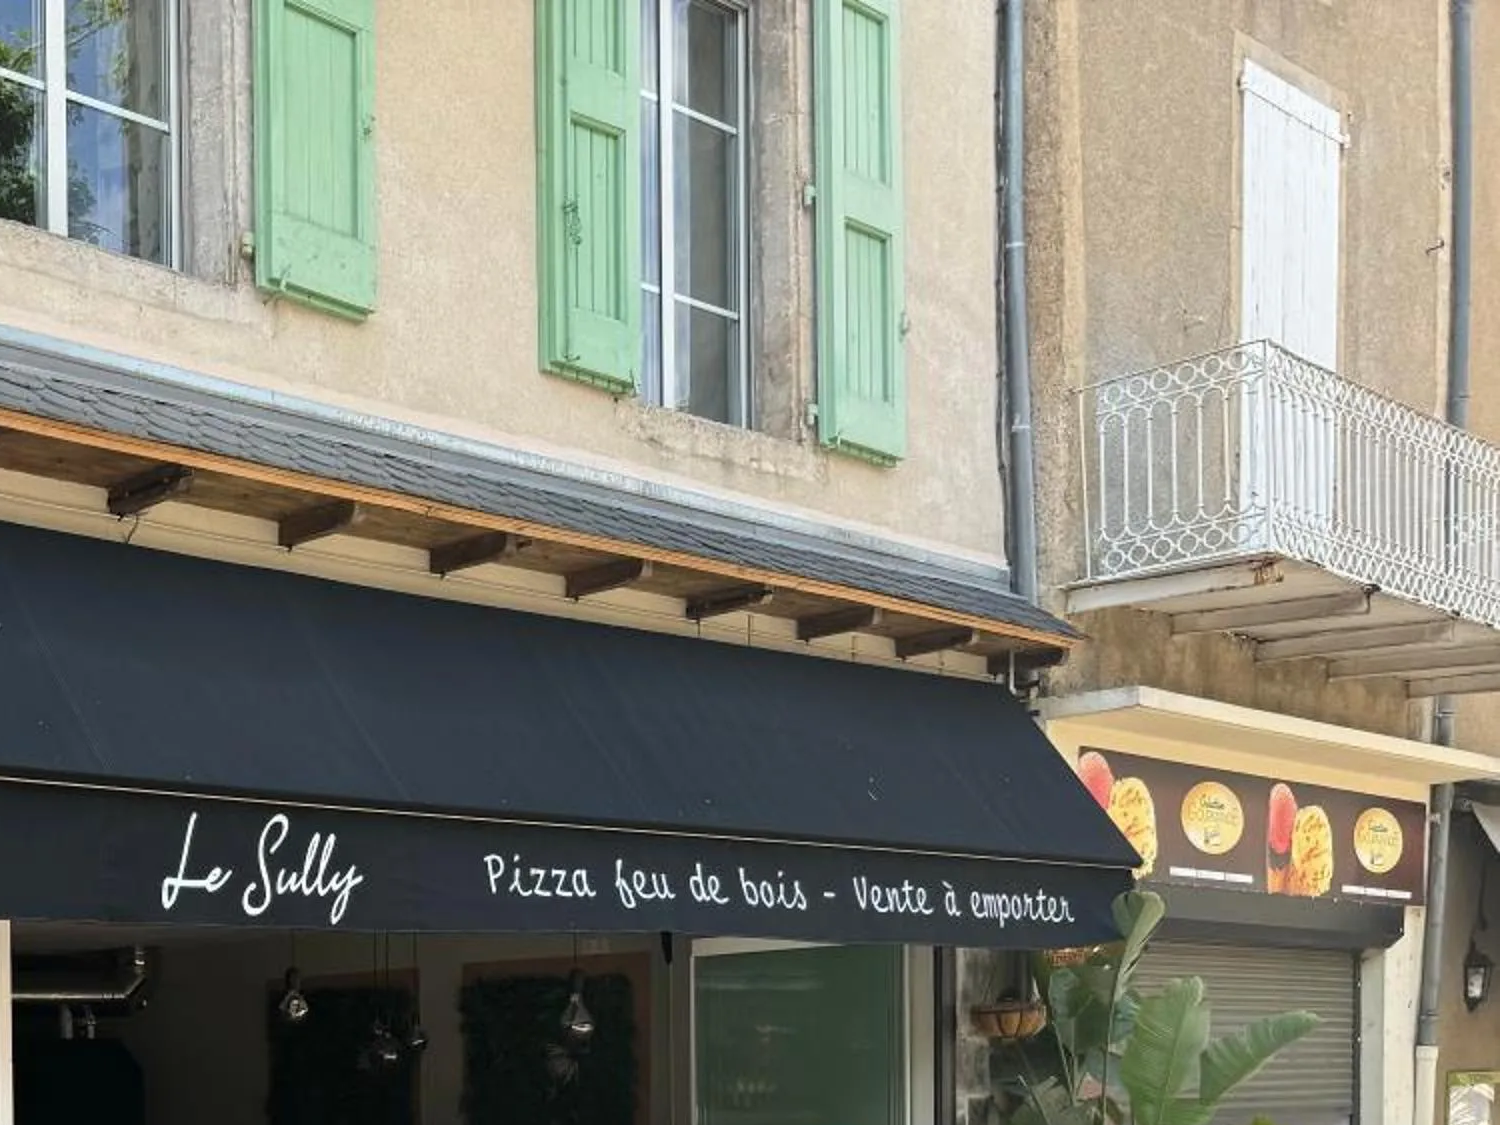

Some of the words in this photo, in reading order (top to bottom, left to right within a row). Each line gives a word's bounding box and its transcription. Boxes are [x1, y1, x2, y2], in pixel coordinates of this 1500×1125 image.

[161, 811, 233, 910] Le
[241, 812, 365, 926] Sully
[483, 853, 597, 898] Pizza
[615, 858, 676, 909] feu
[688, 862, 730, 905] de
[738, 867, 808, 911] bois
[852, 876, 934, 916] Vente
[942, 880, 962, 917] à
[970, 888, 1075, 928] emporter
